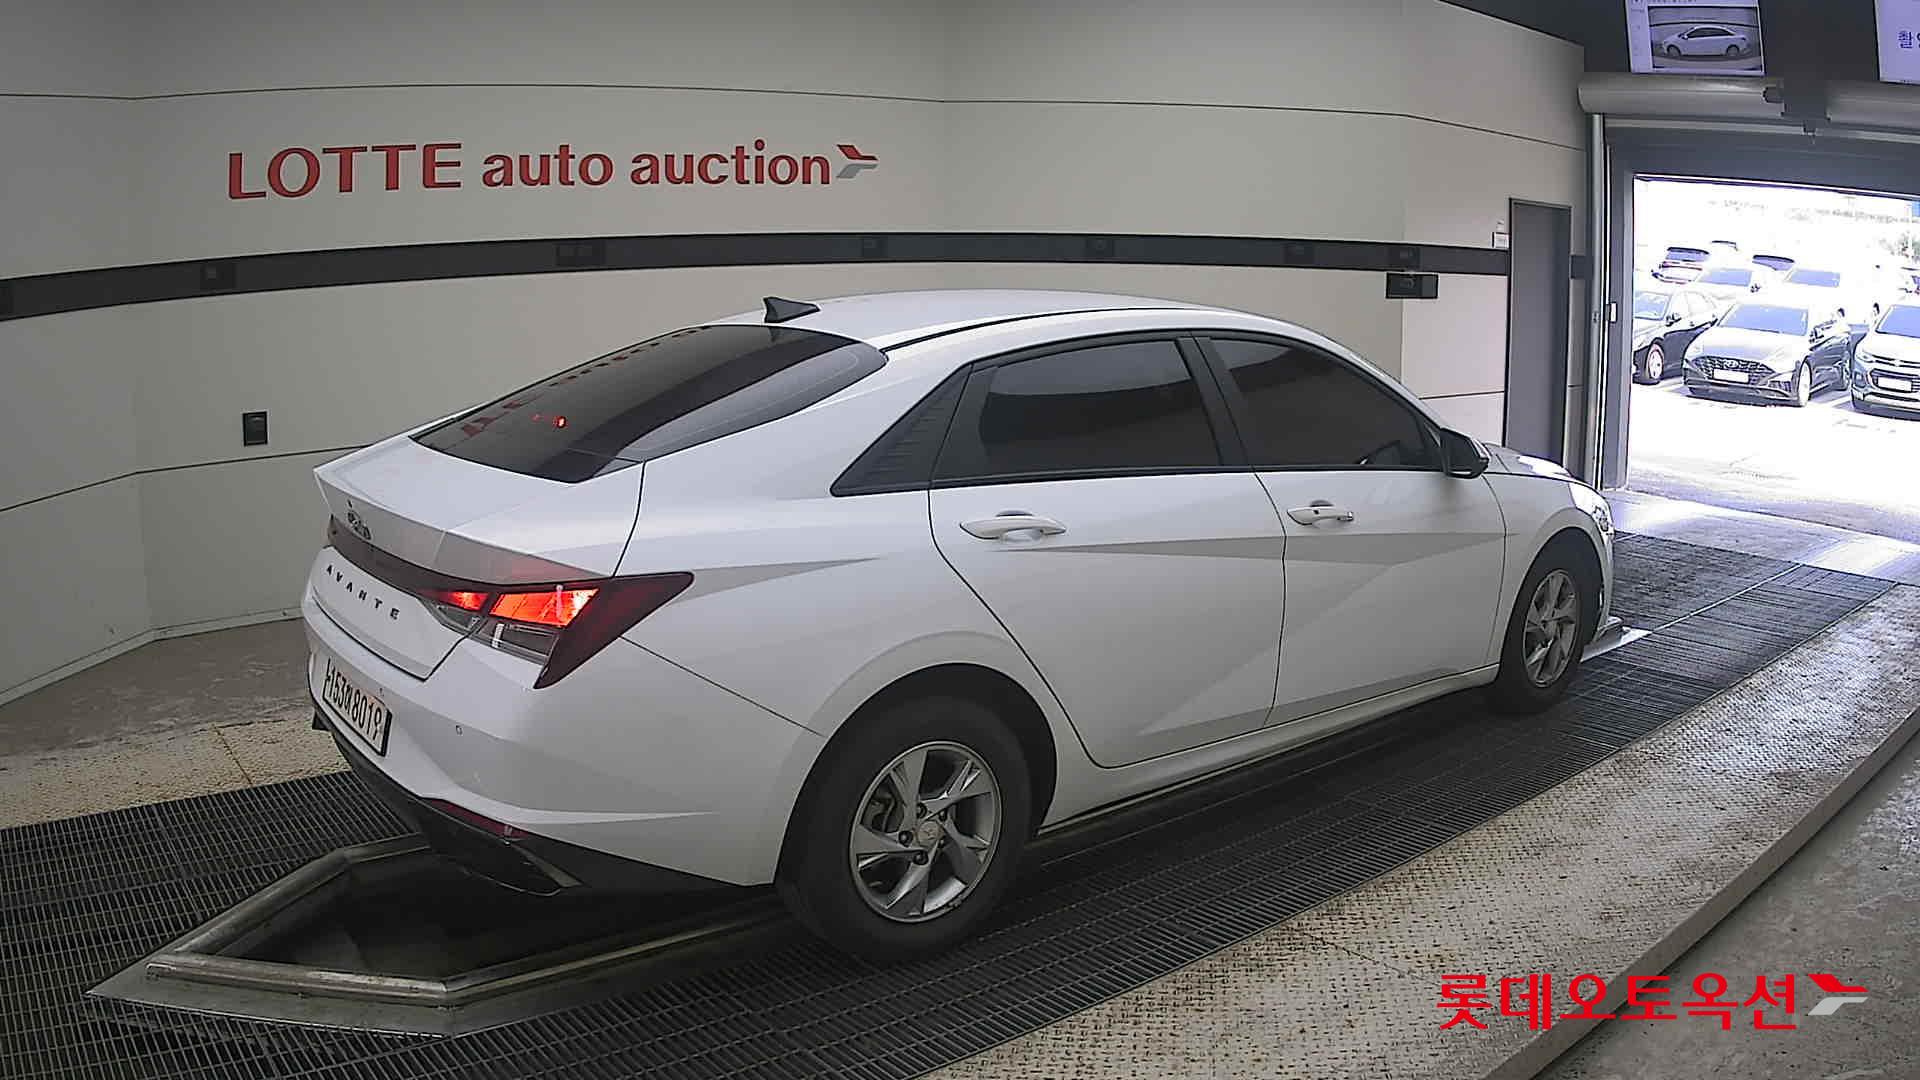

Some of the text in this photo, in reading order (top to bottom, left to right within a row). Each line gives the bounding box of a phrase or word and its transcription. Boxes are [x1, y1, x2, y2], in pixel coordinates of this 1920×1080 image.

[227, 139, 831, 200] LOTTE auto auction
[326, 564, 400, 620] AVANTE
